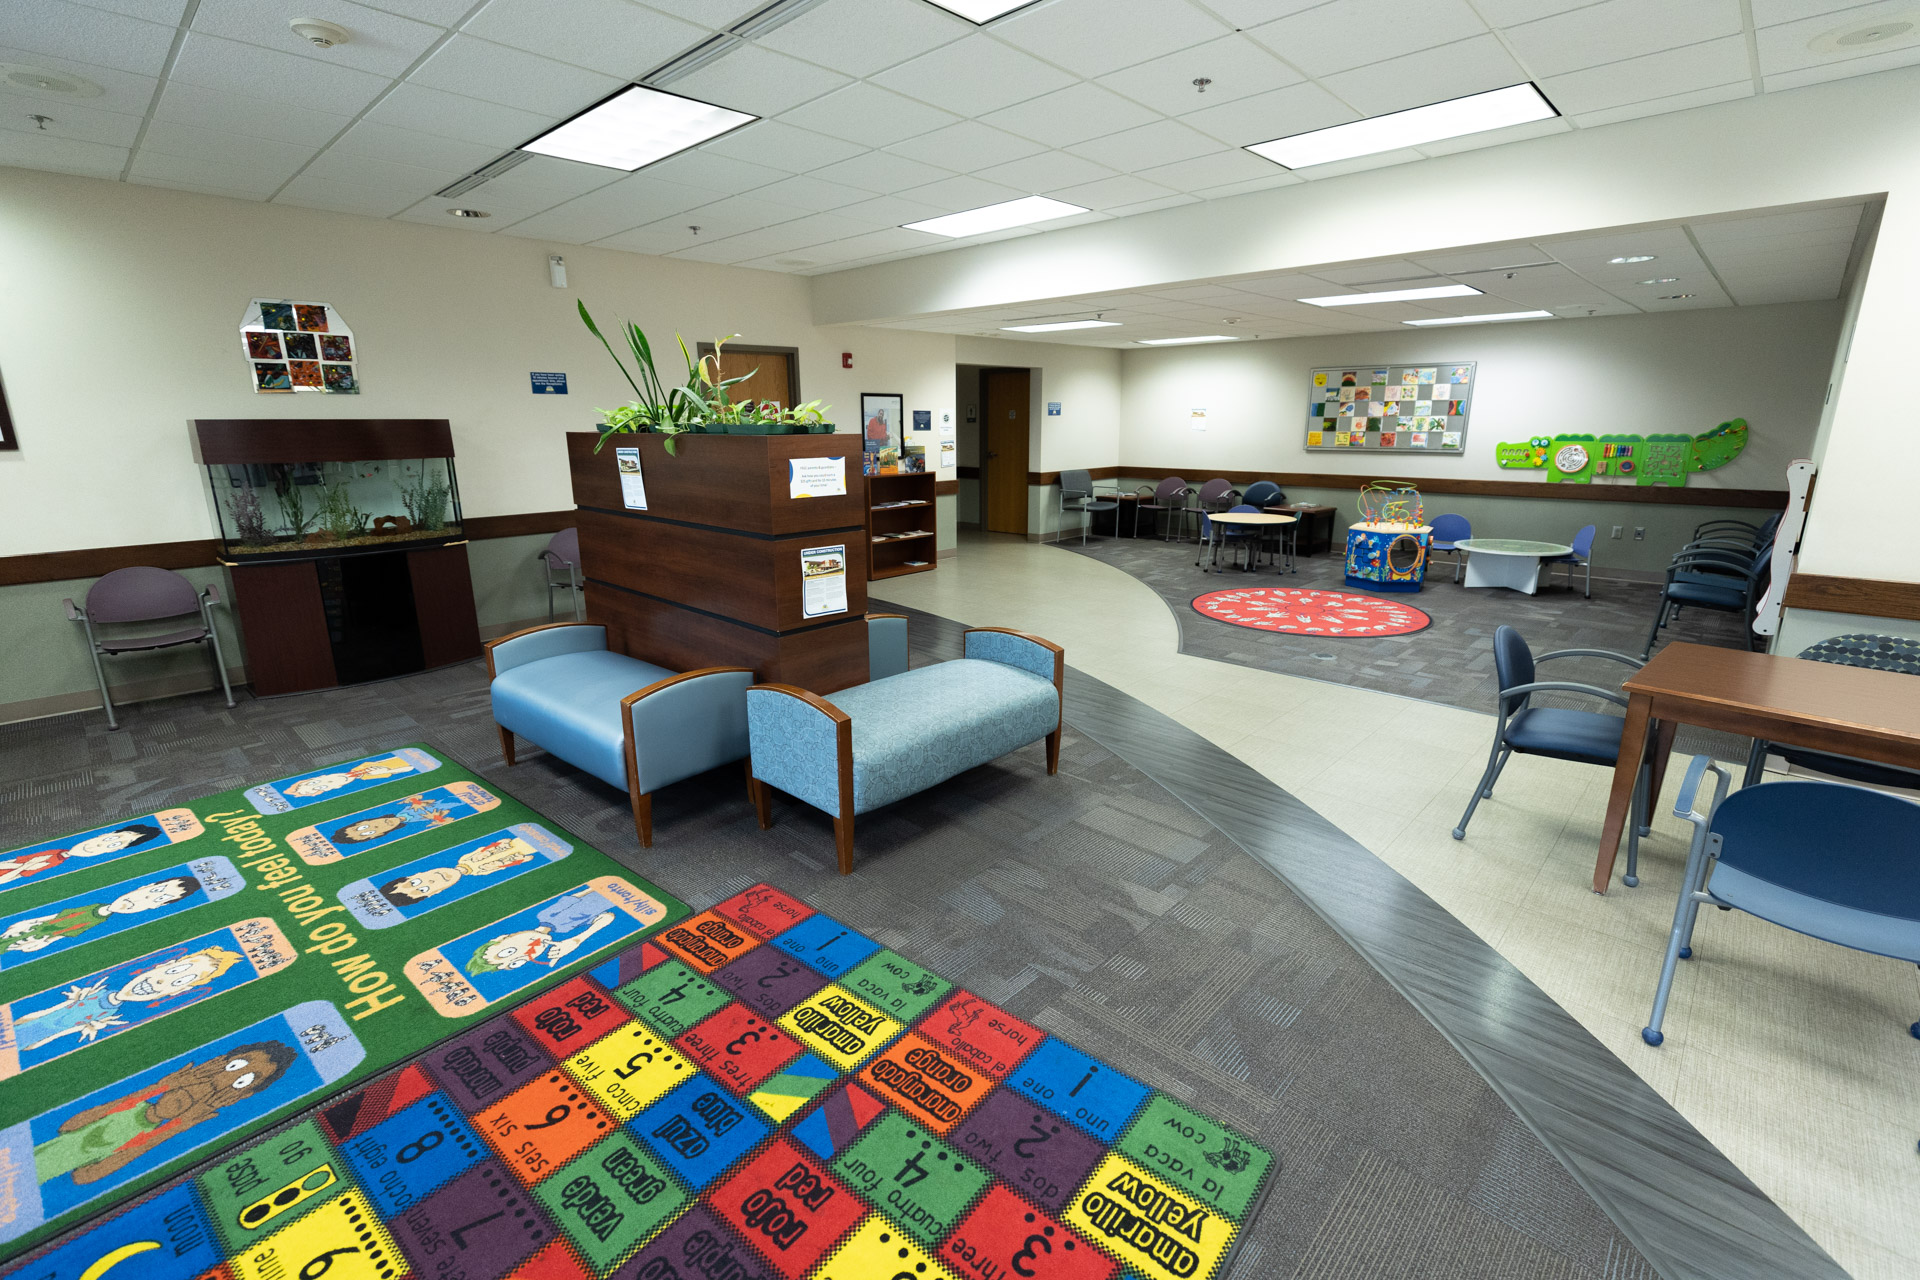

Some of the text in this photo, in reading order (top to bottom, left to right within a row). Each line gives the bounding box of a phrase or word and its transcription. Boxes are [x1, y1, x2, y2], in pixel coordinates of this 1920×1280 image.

[204, 809, 406, 1021] How do you feel today?
[608, 882, 657, 916] silly/tonto
[773, 901, 801, 919] horse
[696, 921, 744, 949] orange
[737, 914, 776, 936] el caballo
[783, 938, 839, 973] uno one
[881, 962, 910, 980] cow
[658, 984, 688, 1006] 4
[723, 972, 781, 1011] dos two
[758, 967, 792, 988] 2
[857, 978, 907, 1013] la vaca
[534, 1006, 582, 1042] rojo
[565, 991, 610, 1020] red
[622, 988, 685, 1033] cuatro four
[819, 995, 886, 1036] yellow
[726, 1031, 760, 1055] 3
[793, 1006, 866, 1055] amarillo
[988, 1019, 1029, 1047] horse
[442, 1046, 503, 1100] morado
[484, 1031, 541, 1075] purple
[613, 1052, 653, 1080] 5
[685, 1034, 752, 1088] tres three
[905, 1048, 973, 1093] orange
[951, 1037, 1006, 1072] el caballo
[576, 1055, 640, 1111] cinco five
[871, 1059, 963, 1123] anaranjado
[524, 1105, 570, 1130] 6
[692, 1092, 744, 1137] blue
[1023, 1077, 1110, 1132] uno one
[396, 1131, 444, 1164] 8
[490, 1113, 549, 1173] seis six
[652, 1114, 710, 1159] azul
[1014, 1125, 1052, 1158] 2
[1164, 1117, 1206, 1145] cow
[279, 1140, 313, 1166] go
[349, 1137, 412, 1207] ocho eight
[893, 1151, 929, 1188] 4
[965, 1132, 1059, 1199] dos two
[1144, 1143, 1224, 1200] la vaca
[225, 1158, 270, 1197] pase
[602, 1147, 666, 1205] green
[774, 1162, 835, 1213] red
[844, 1158, 943, 1236] cuatro four
[561, 1175, 625, 1243] verde
[740, 1189, 808, 1251] rojo
[1106, 1171, 1210, 1244] yellow
[163, 1204, 205, 1258] moon
[406, 1208, 446, 1255] seven
[451, 1210, 505, 1250] 7
[1082, 1191, 1200, 1279] amarillo
[299, 1246, 360, 1280] 9
[1012, 1234, 1052, 1278] 3
